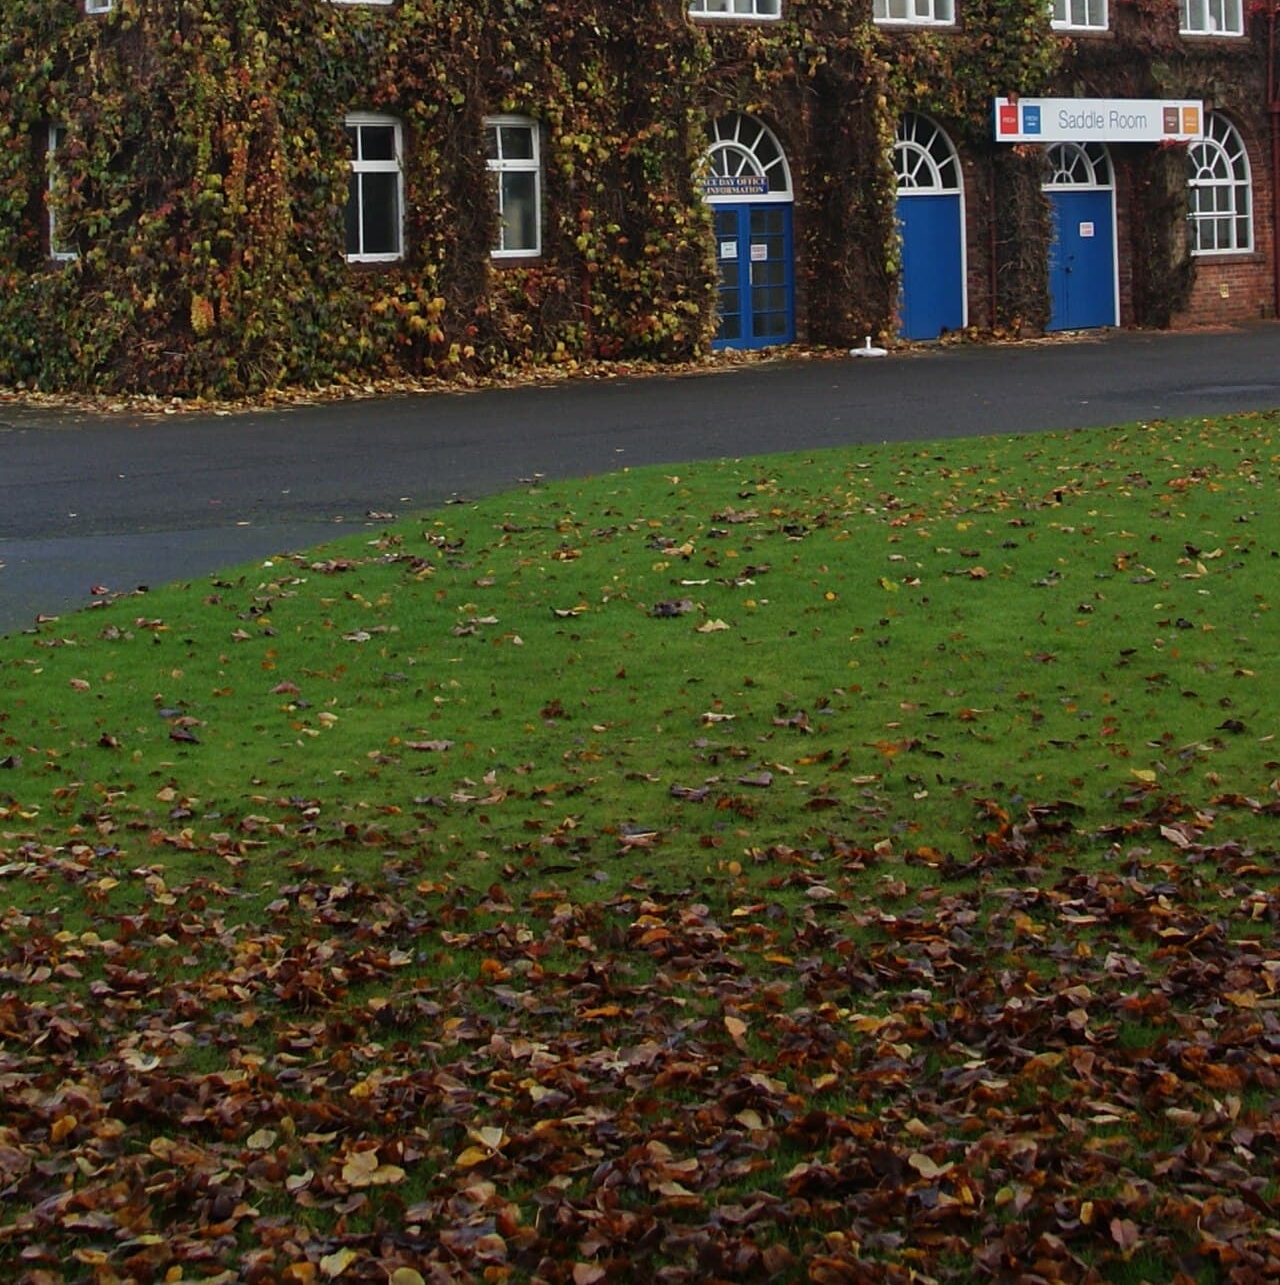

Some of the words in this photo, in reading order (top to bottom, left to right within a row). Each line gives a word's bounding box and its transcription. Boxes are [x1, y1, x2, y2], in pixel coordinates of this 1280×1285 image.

[1058, 110, 1105, 129] Saddle
[1109, 111, 1148, 129] Room
[719, 178, 735, 186] DAY
[736, 177, 766, 185] OFFICE
[706, 186, 764, 194] INFORMATION
